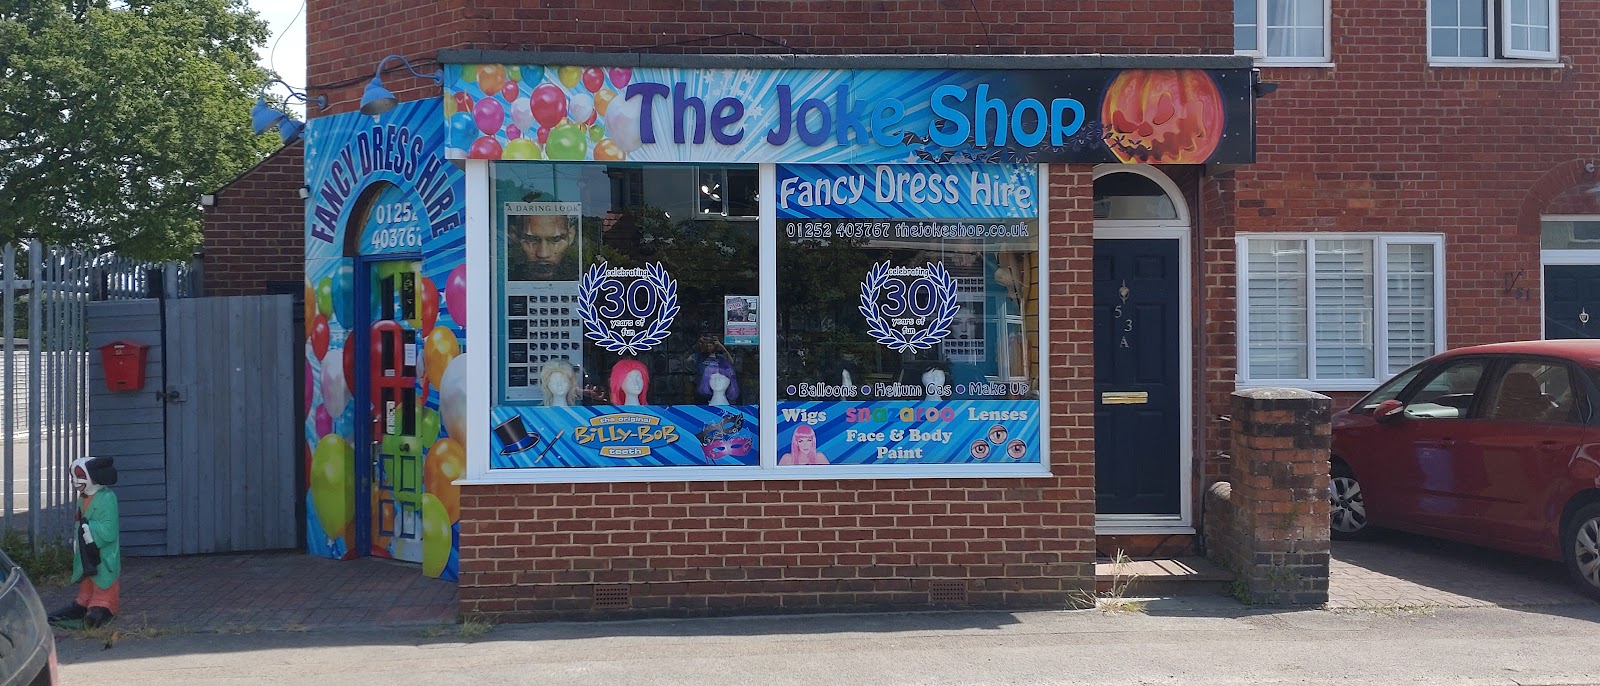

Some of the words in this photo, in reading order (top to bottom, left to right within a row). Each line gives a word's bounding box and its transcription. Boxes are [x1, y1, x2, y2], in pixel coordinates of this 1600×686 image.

[625, 82, 745, 146] The
[767, 84, 905, 147] Joke
[928, 83, 1086, 148] Shop
[310, 143, 359, 244] FANCY
[357, 124, 424, 182] DRESS
[413, 152, 461, 239] HIRE
[780, 174, 865, 209] Fancy
[875, 165, 960, 205] Dress
[970, 171, 1032, 209] Hire
[785, 222, 832, 238] 01252
[835, 222, 891, 238] 403767
[894, 221, 1030, 238] thejokeshop.co.uk
[606, 267, 649, 279] celebrating
[887, 266, 930, 278] celebrating
[600, 278, 658, 319] 30
[881, 277, 938, 318] 30
[610, 319, 634, 329] years
[634, 317, 646, 327] of
[891, 318, 915, 328] years
[915, 316, 926, 326] of
[901, 325, 916, 335] fun
[620, 327, 636, 337] fun
[798, 382, 858, 397] Balloons
[874, 381, 922, 397] Helium
[925, 382, 953, 397] Gas
[968, 381, 1007, 396] Make
[1009, 381, 1030, 396] Up
[618, 416, 652, 424] original
[782, 408, 827, 426] Wigs
[846, 406, 955, 423] snazaroo
[967, 407, 1029, 421] Lenses
[846, 429, 885, 442] Face
[889, 428, 905, 442] &
[908, 428, 954, 444] Body
[876, 446, 924, 459] Paint
